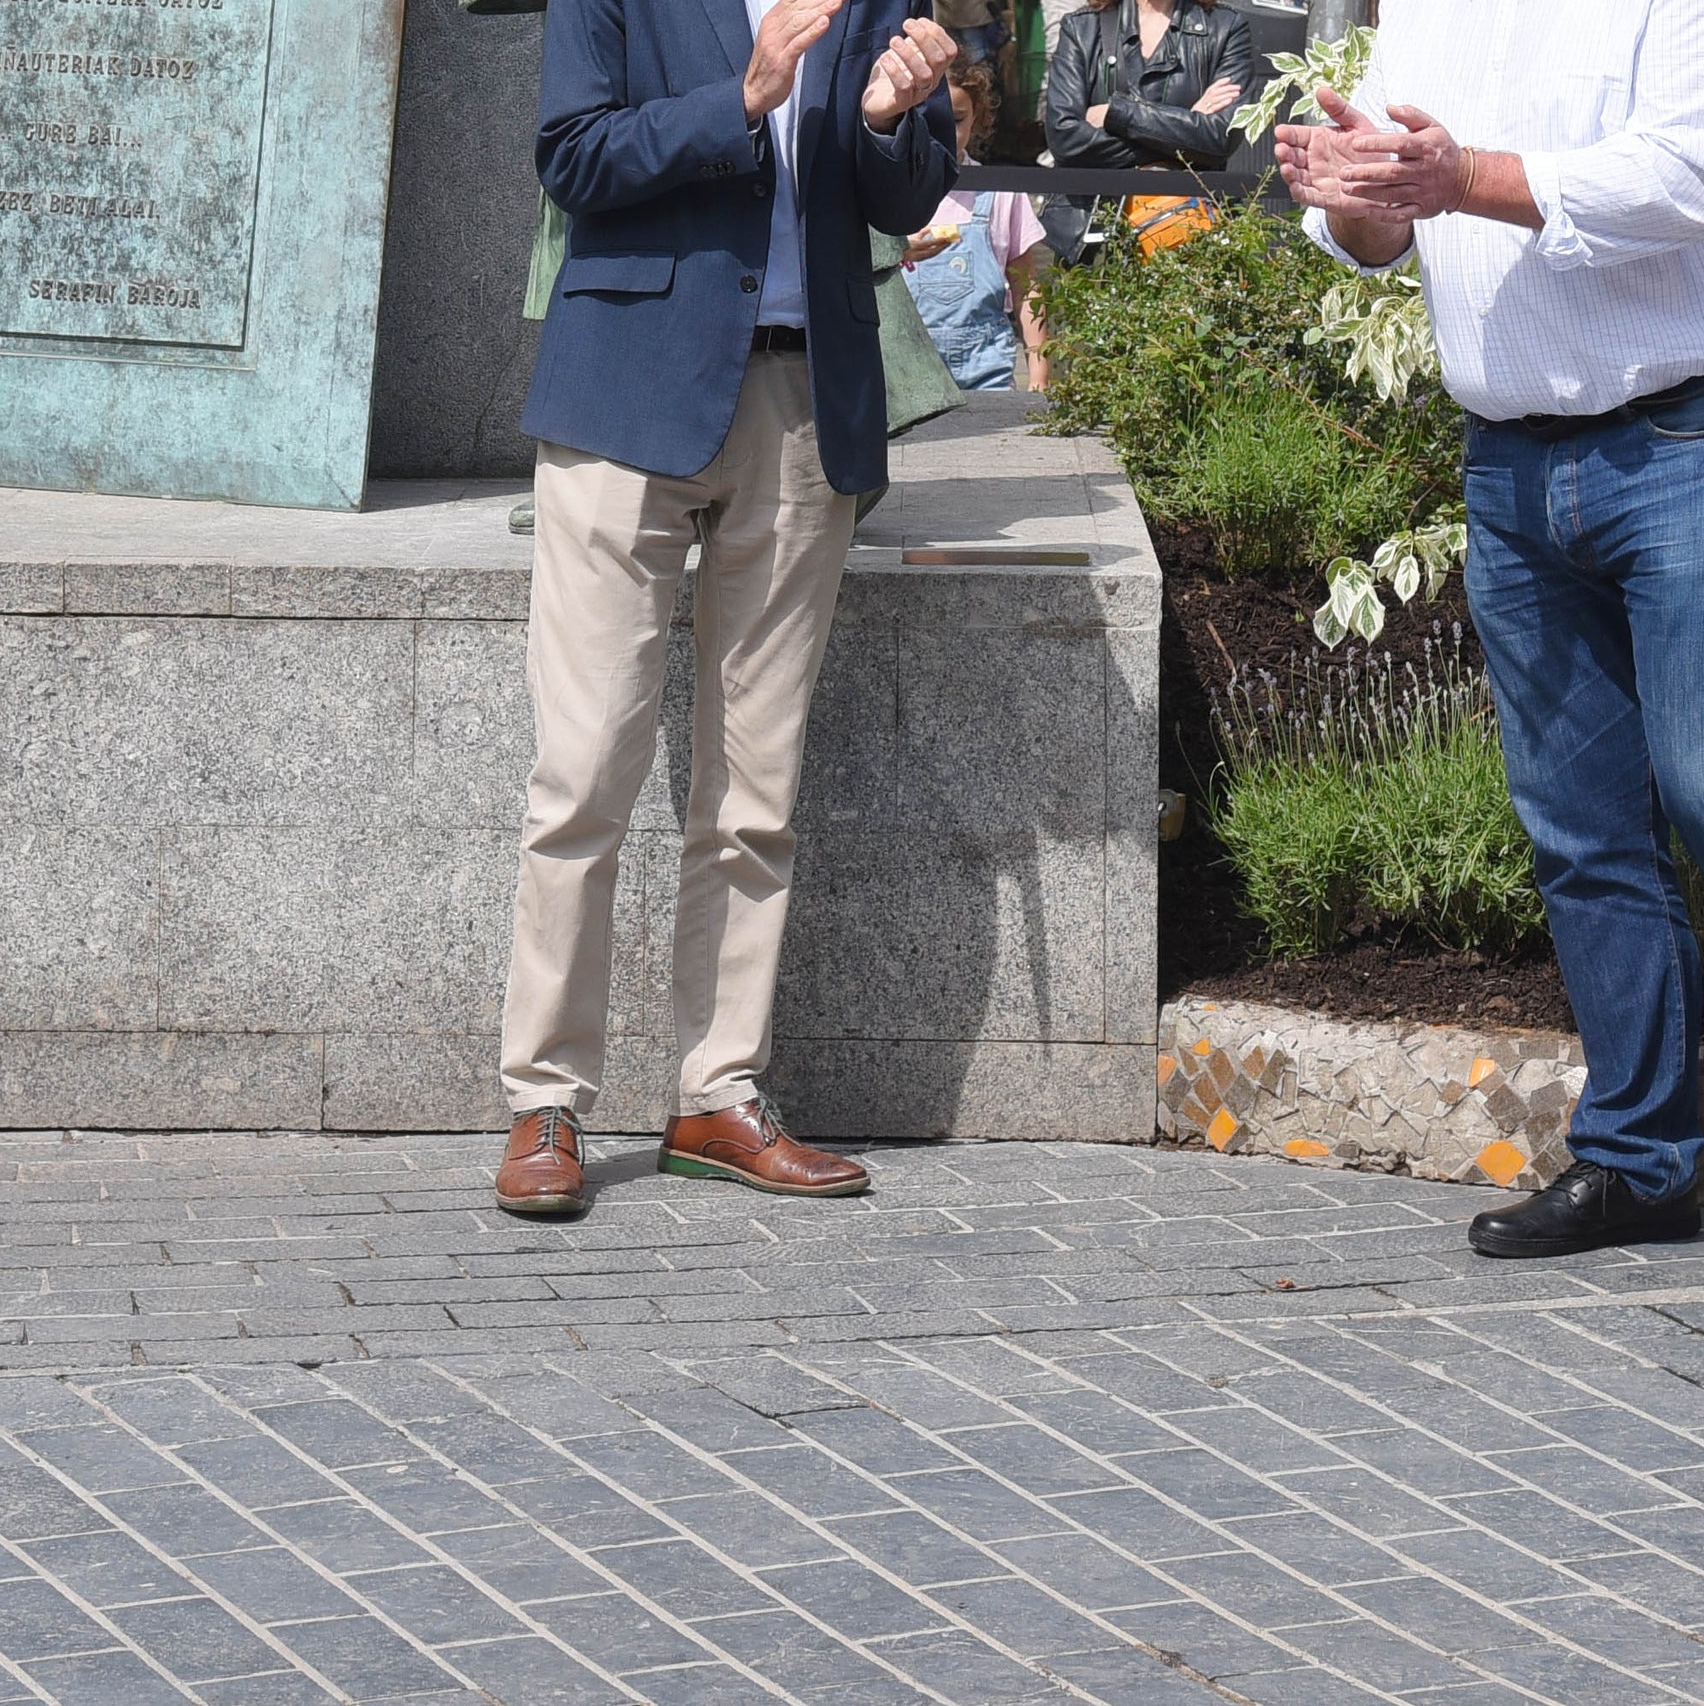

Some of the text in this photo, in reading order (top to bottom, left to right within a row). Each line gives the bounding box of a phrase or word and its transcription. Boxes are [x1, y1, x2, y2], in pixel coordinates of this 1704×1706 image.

[130, 57, 194, 80] DATOZ
[24, 121, 77, 144] GURE
[49, 193, 95, 217] BETI
[28, 279, 201, 309] SERAFIN BAROJA
